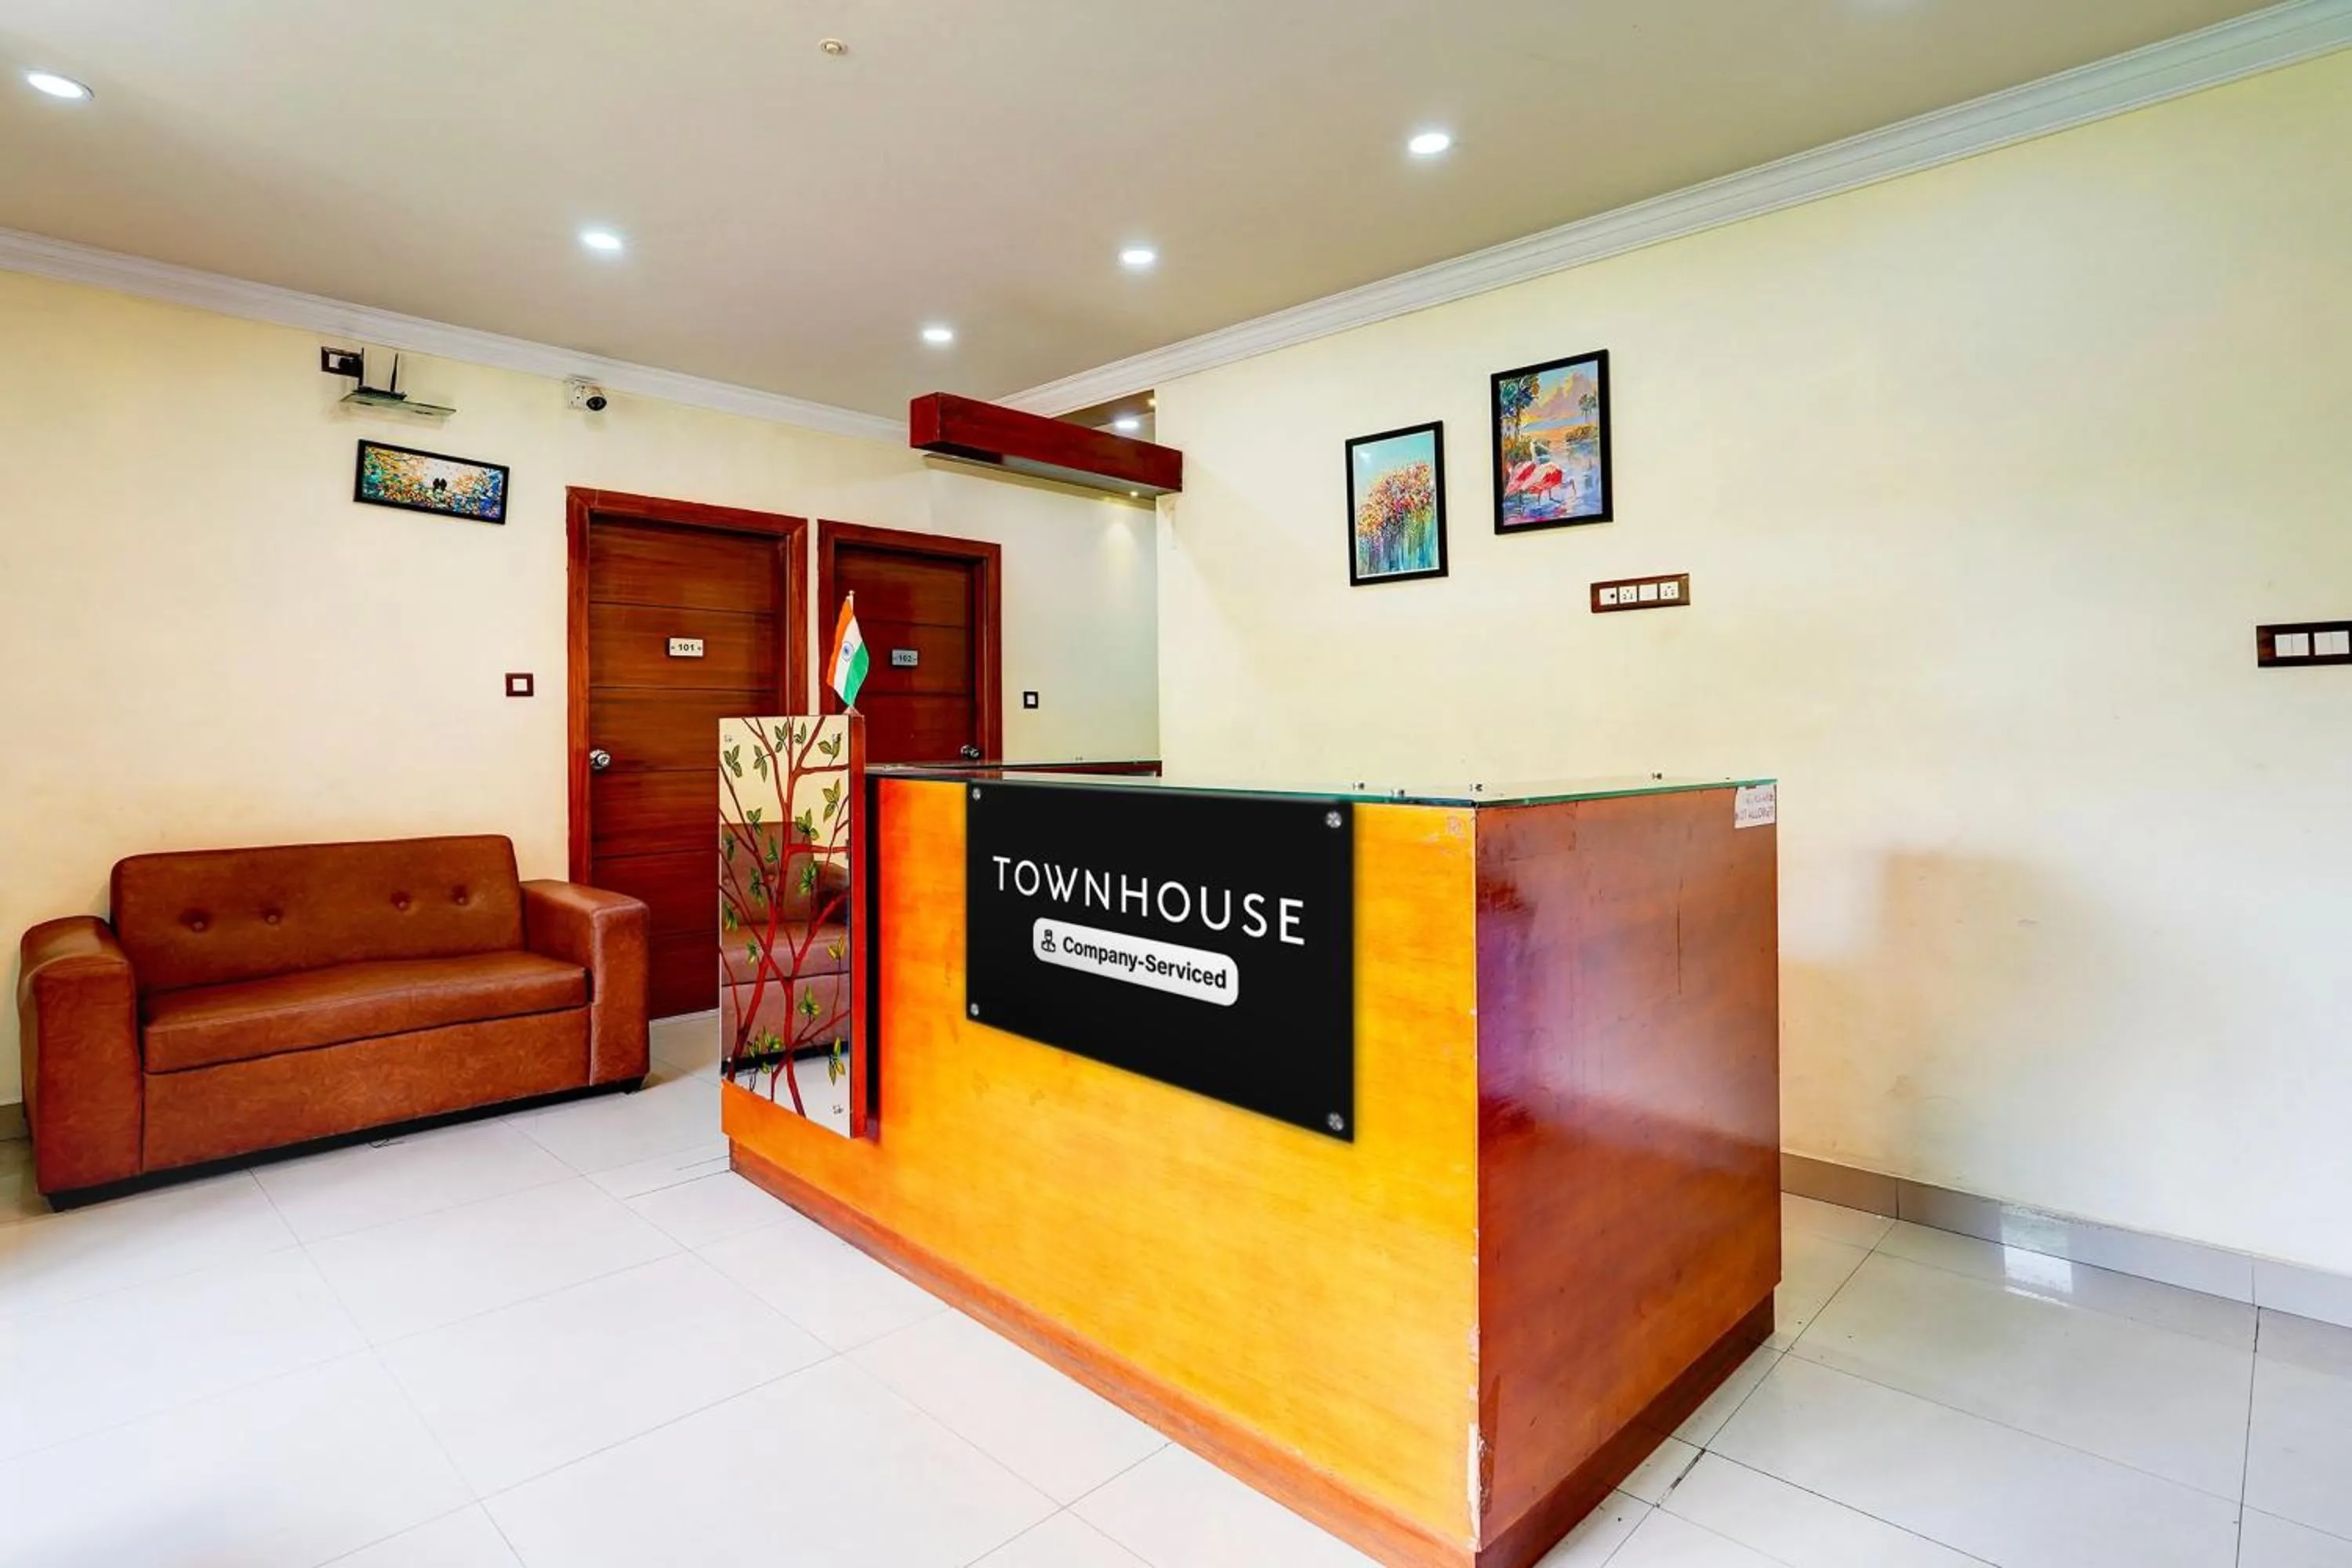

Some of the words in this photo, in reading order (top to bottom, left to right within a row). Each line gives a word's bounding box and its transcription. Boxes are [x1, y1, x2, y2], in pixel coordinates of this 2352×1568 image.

[678, 643, 695, 652] 101
[993, 855, 1305, 946] TOWNHOUSE
[1062, 937, 1227, 989] Company-Serviced
